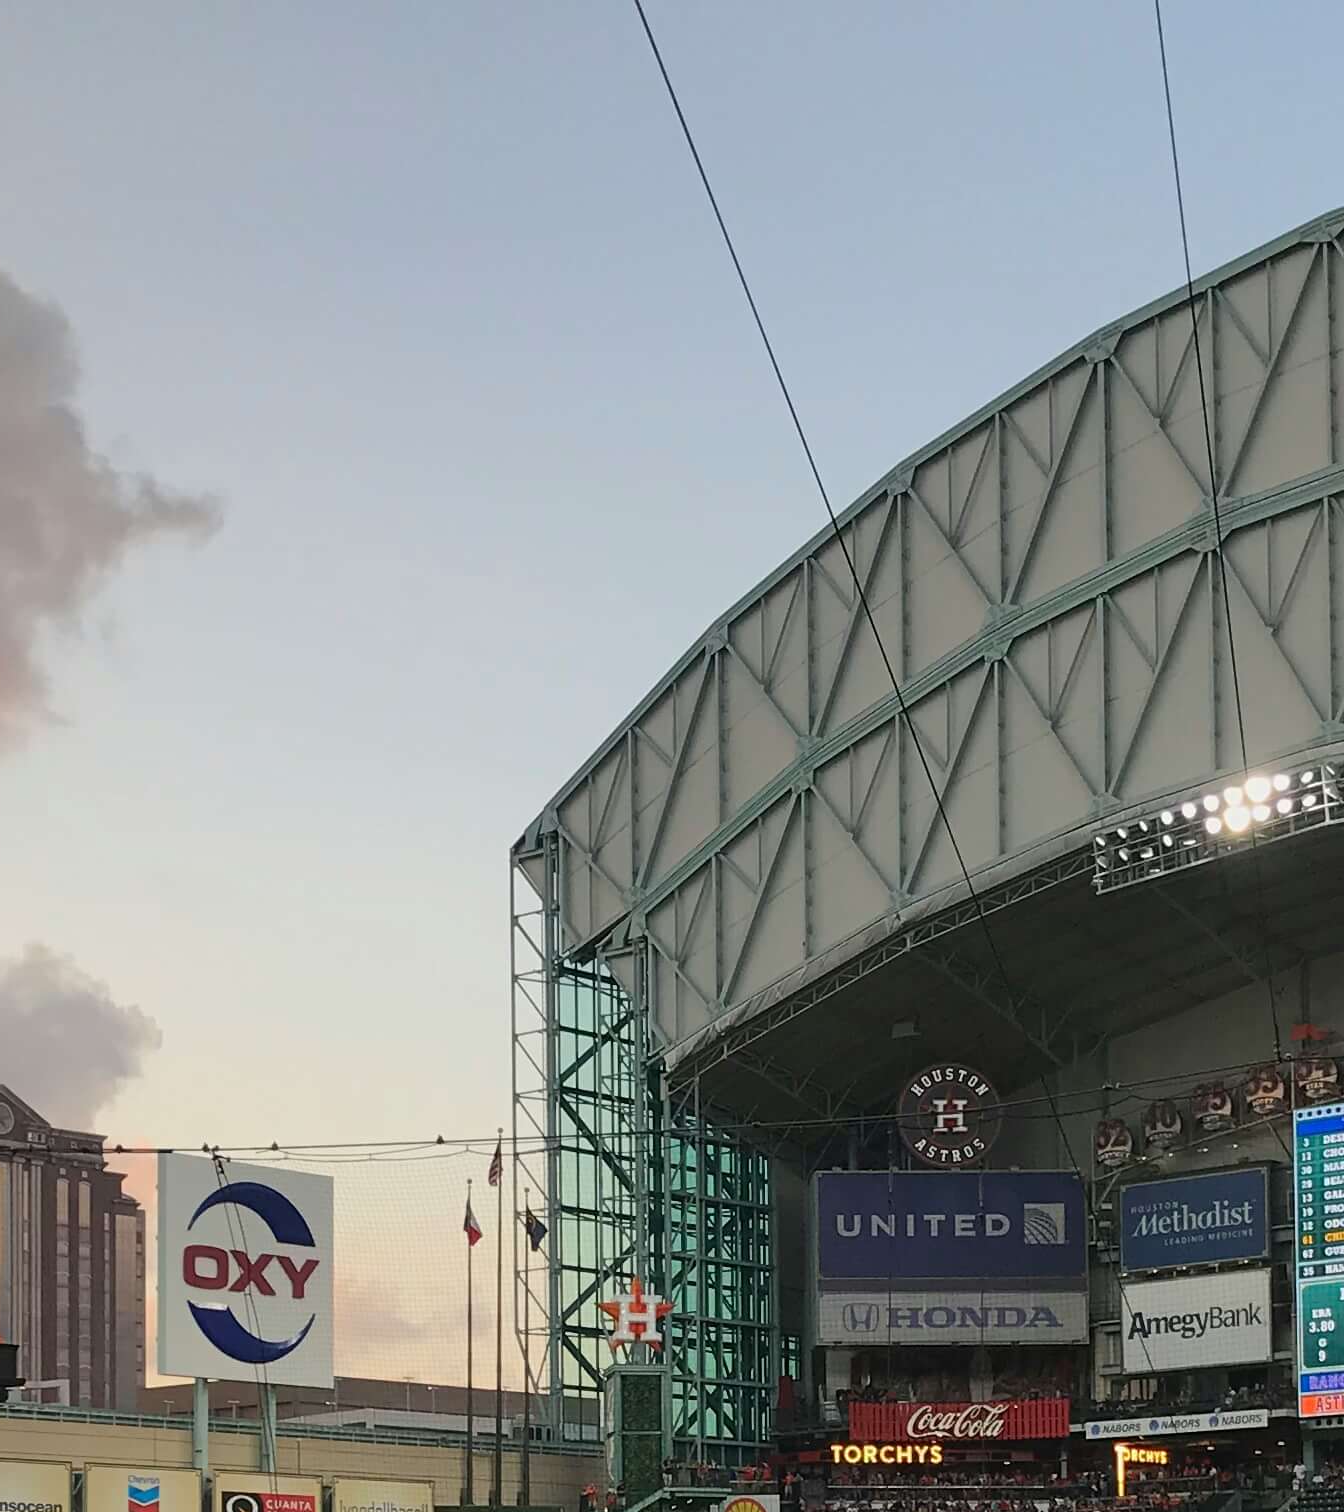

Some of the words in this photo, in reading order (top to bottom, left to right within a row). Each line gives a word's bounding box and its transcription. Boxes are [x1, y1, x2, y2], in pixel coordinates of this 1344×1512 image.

[910, 1067, 990, 1097] HOUSTON
[932, 1099, 968, 1132] H
[914, 1138, 985, 1162] ASTROS
[1130, 1201, 1179, 1215] HOUSTON
[1131, 1200, 1254, 1238] Methodist
[836, 1213, 1012, 1239] UNITED
[1163, 1234, 1204, 1247] LEADING
[1208, 1227, 1254, 1242] MEDICINE
[182, 1243, 321, 1299] OXY
[885, 1305, 1063, 1330] HONDA
[1128, 1302, 1263, 1340] AmegyBank
[1309, 1319, 1335, 1333] 3.80
[906, 1403, 1009, 1439] Coca-Cola
[1102, 1422, 1141, 1435] NABORS
[1161, 1417, 1201, 1430] NABORS
[1221, 1414, 1263, 1427] NABORS
[830, 1444, 944, 1465] TORCHYS
